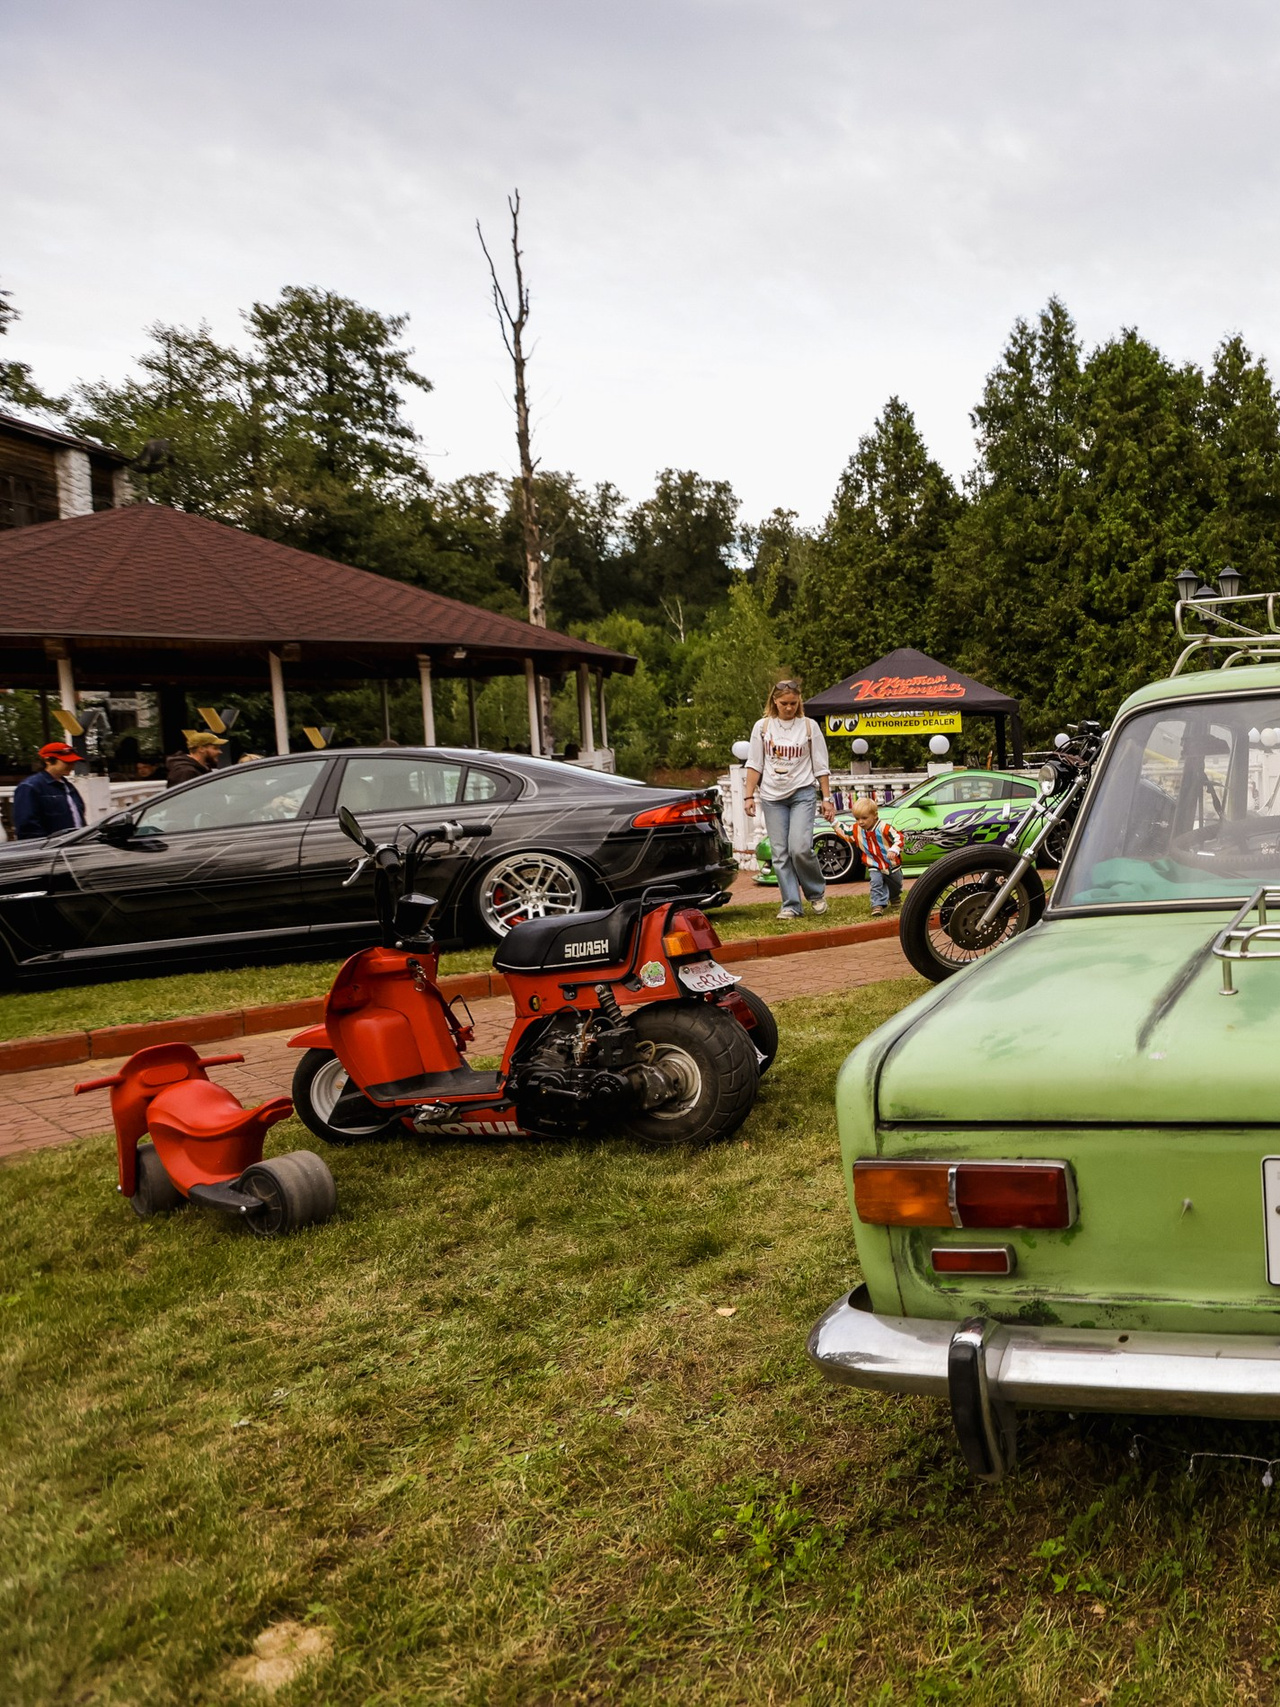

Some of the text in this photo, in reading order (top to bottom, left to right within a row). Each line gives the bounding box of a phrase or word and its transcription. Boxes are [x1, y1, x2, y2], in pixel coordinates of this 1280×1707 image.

[865, 717, 955, 728] AUTHORIZED DEALER
[564, 939, 609, 958] SQUASH
[413, 1120, 528, 1137] MOTUL
